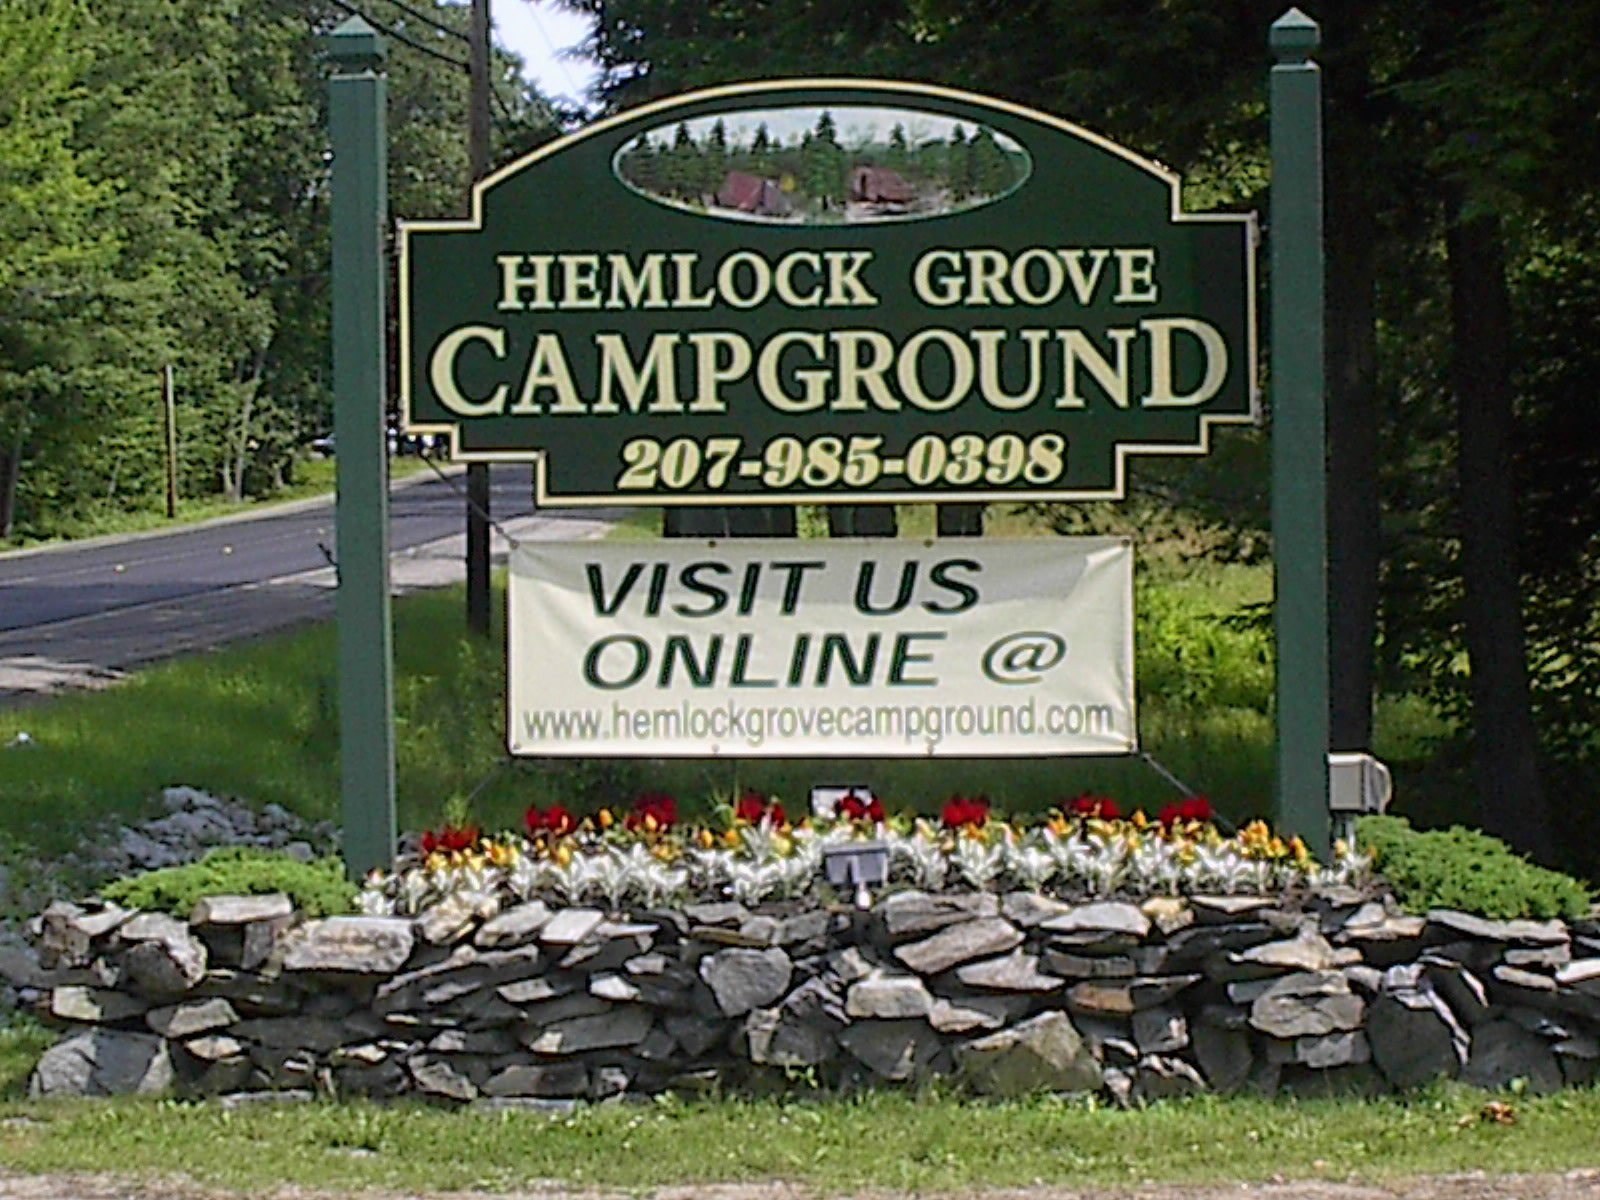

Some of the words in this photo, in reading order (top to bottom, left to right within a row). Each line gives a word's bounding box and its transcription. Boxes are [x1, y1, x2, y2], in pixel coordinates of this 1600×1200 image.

[497, 250, 878, 311] HEMLOCK
[914, 246, 1159, 308] GROVE
[430, 317, 1230, 416] CAMPGROUND
[616, 433, 1065, 490] 207-985-0398
[585, 561, 826, 618] VISIT
[854, 558, 984, 615] US
[582, 632, 948, 690] ONLINE
[981, 630, 1067, 684] @
[523, 697, 1114, 744] www.hemlockgrovecampground.com
